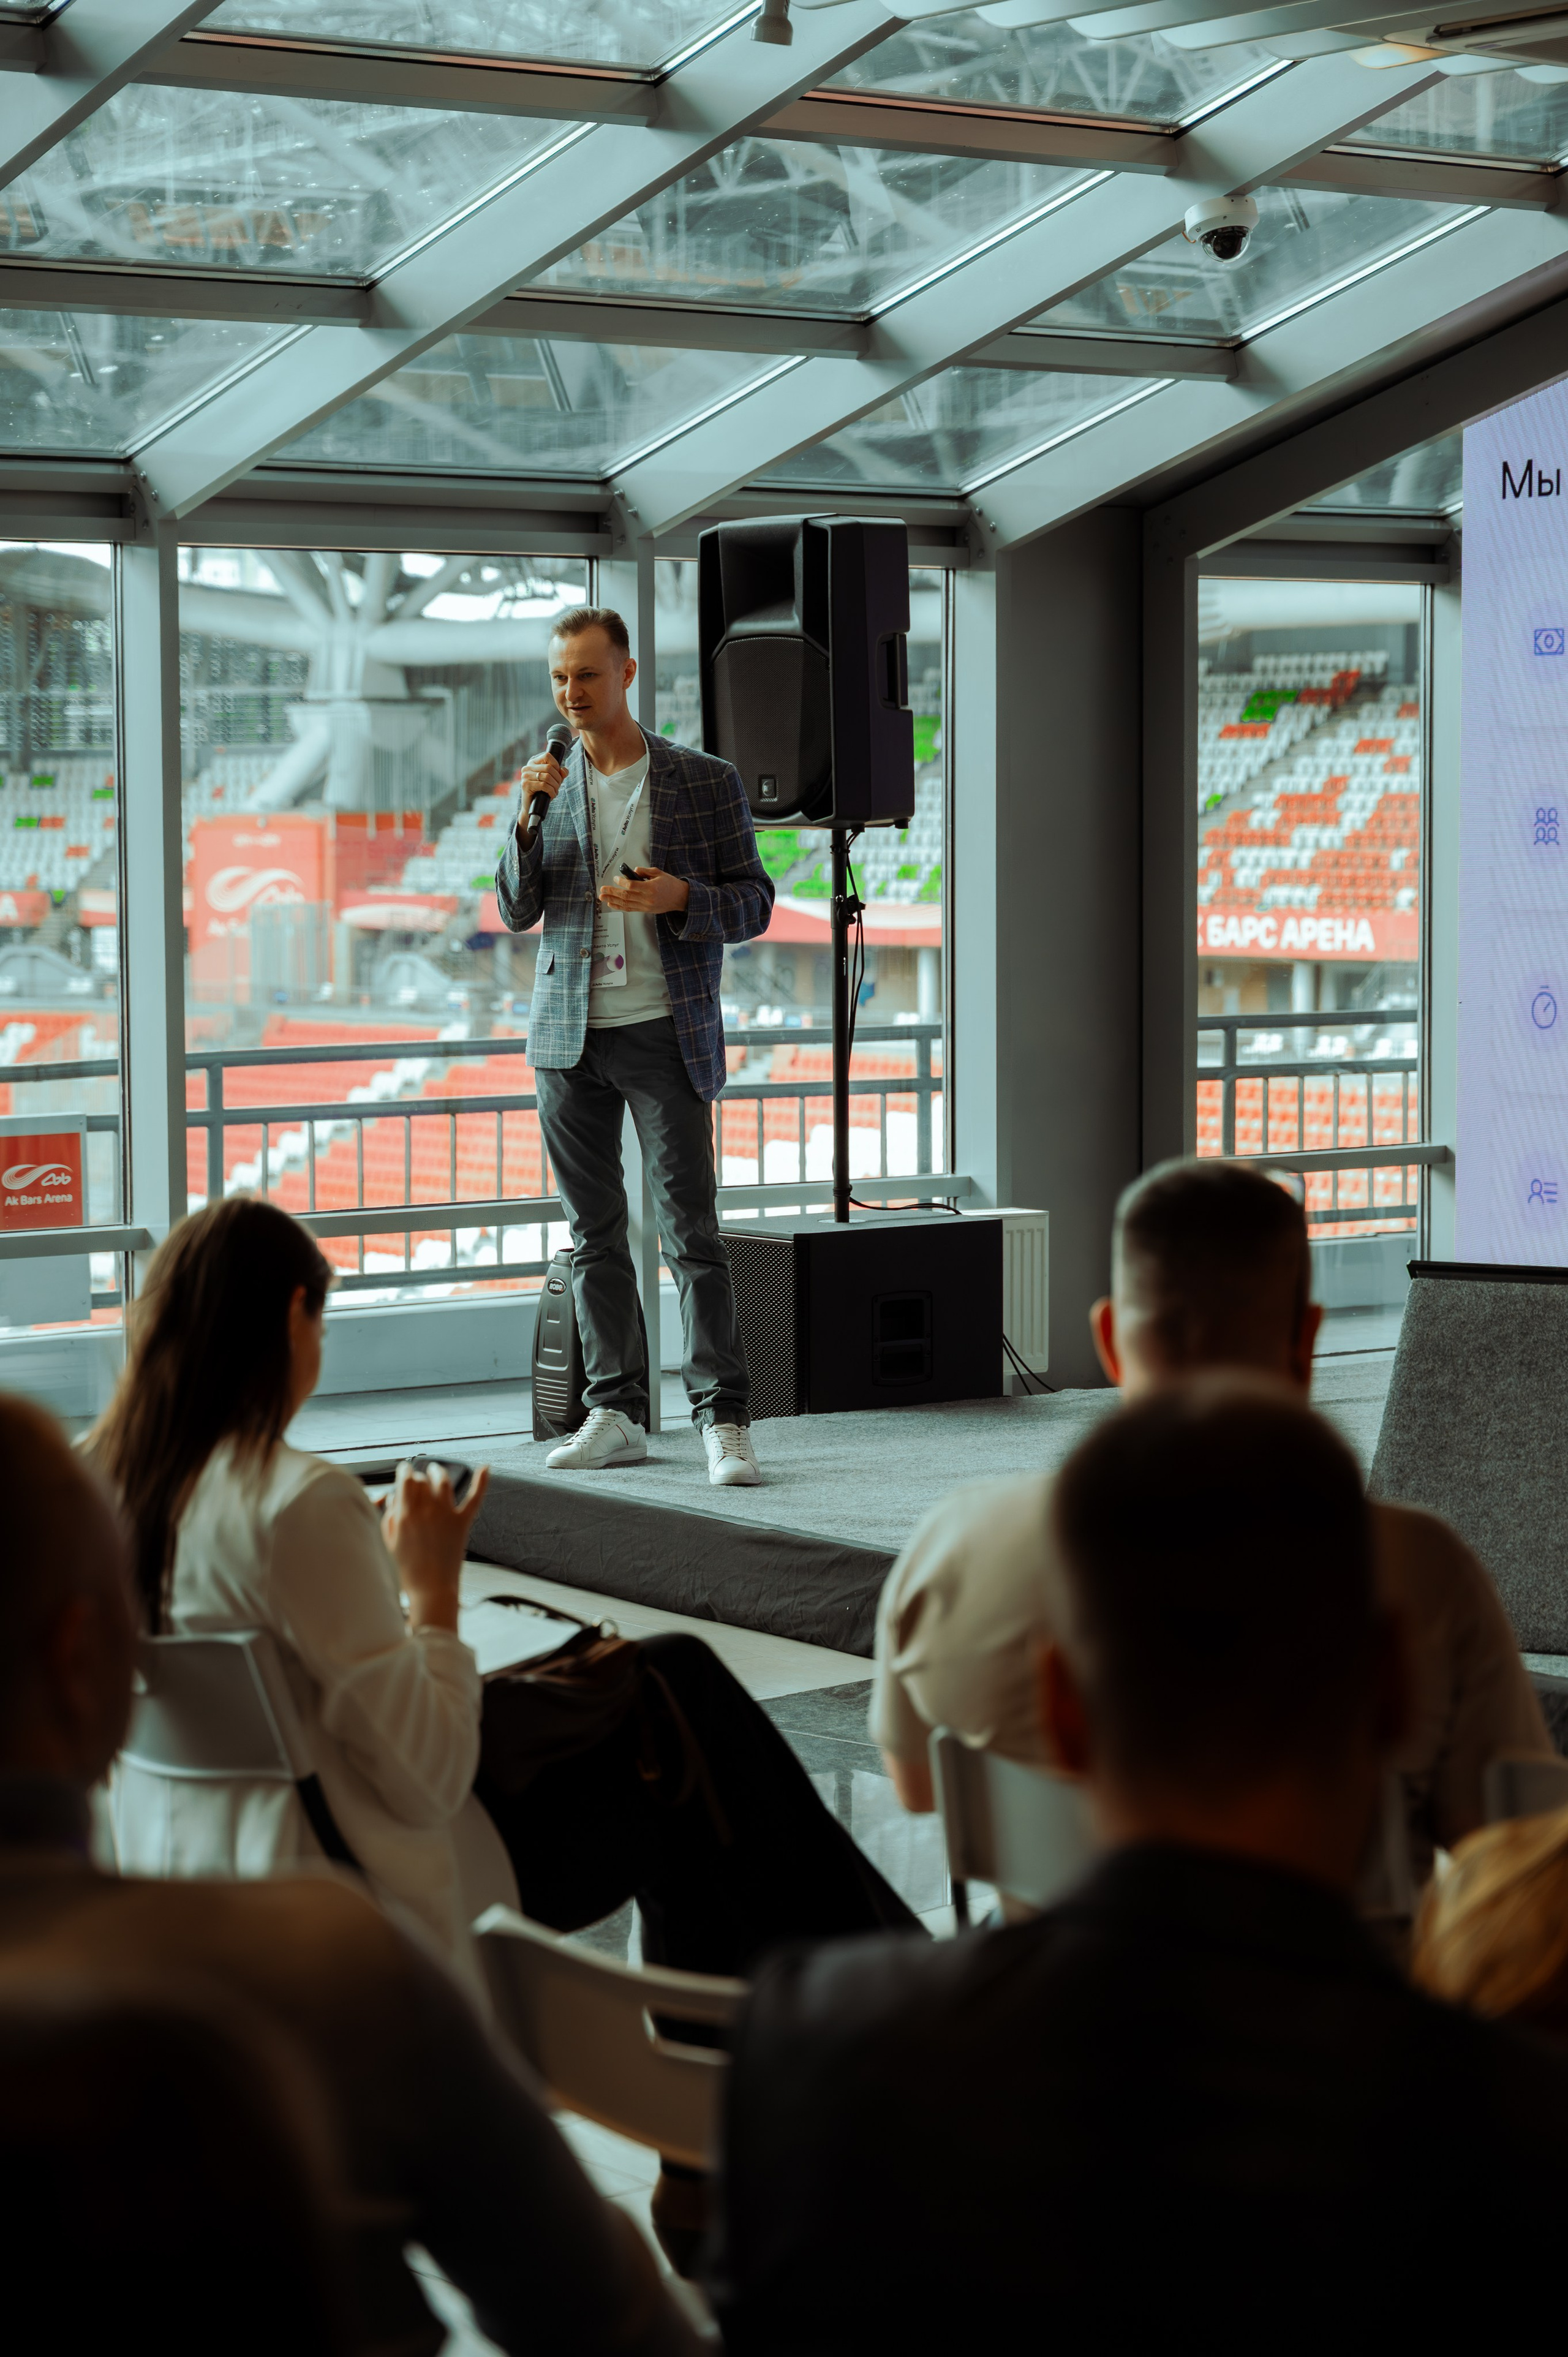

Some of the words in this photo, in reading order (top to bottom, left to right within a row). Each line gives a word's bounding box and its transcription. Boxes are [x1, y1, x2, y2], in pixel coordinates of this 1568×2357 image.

[1502, 459, 1561, 499] Мы
[625, 803, 635, 820] Услуги
[1206, 915, 1278, 949] БАРС
[1280, 916, 1376, 952] АРЕНА
[5, 1196, 19, 1206] Ak
[20, 1195, 42, 1205] Bars
[44, 1193, 73, 1204] Arena
